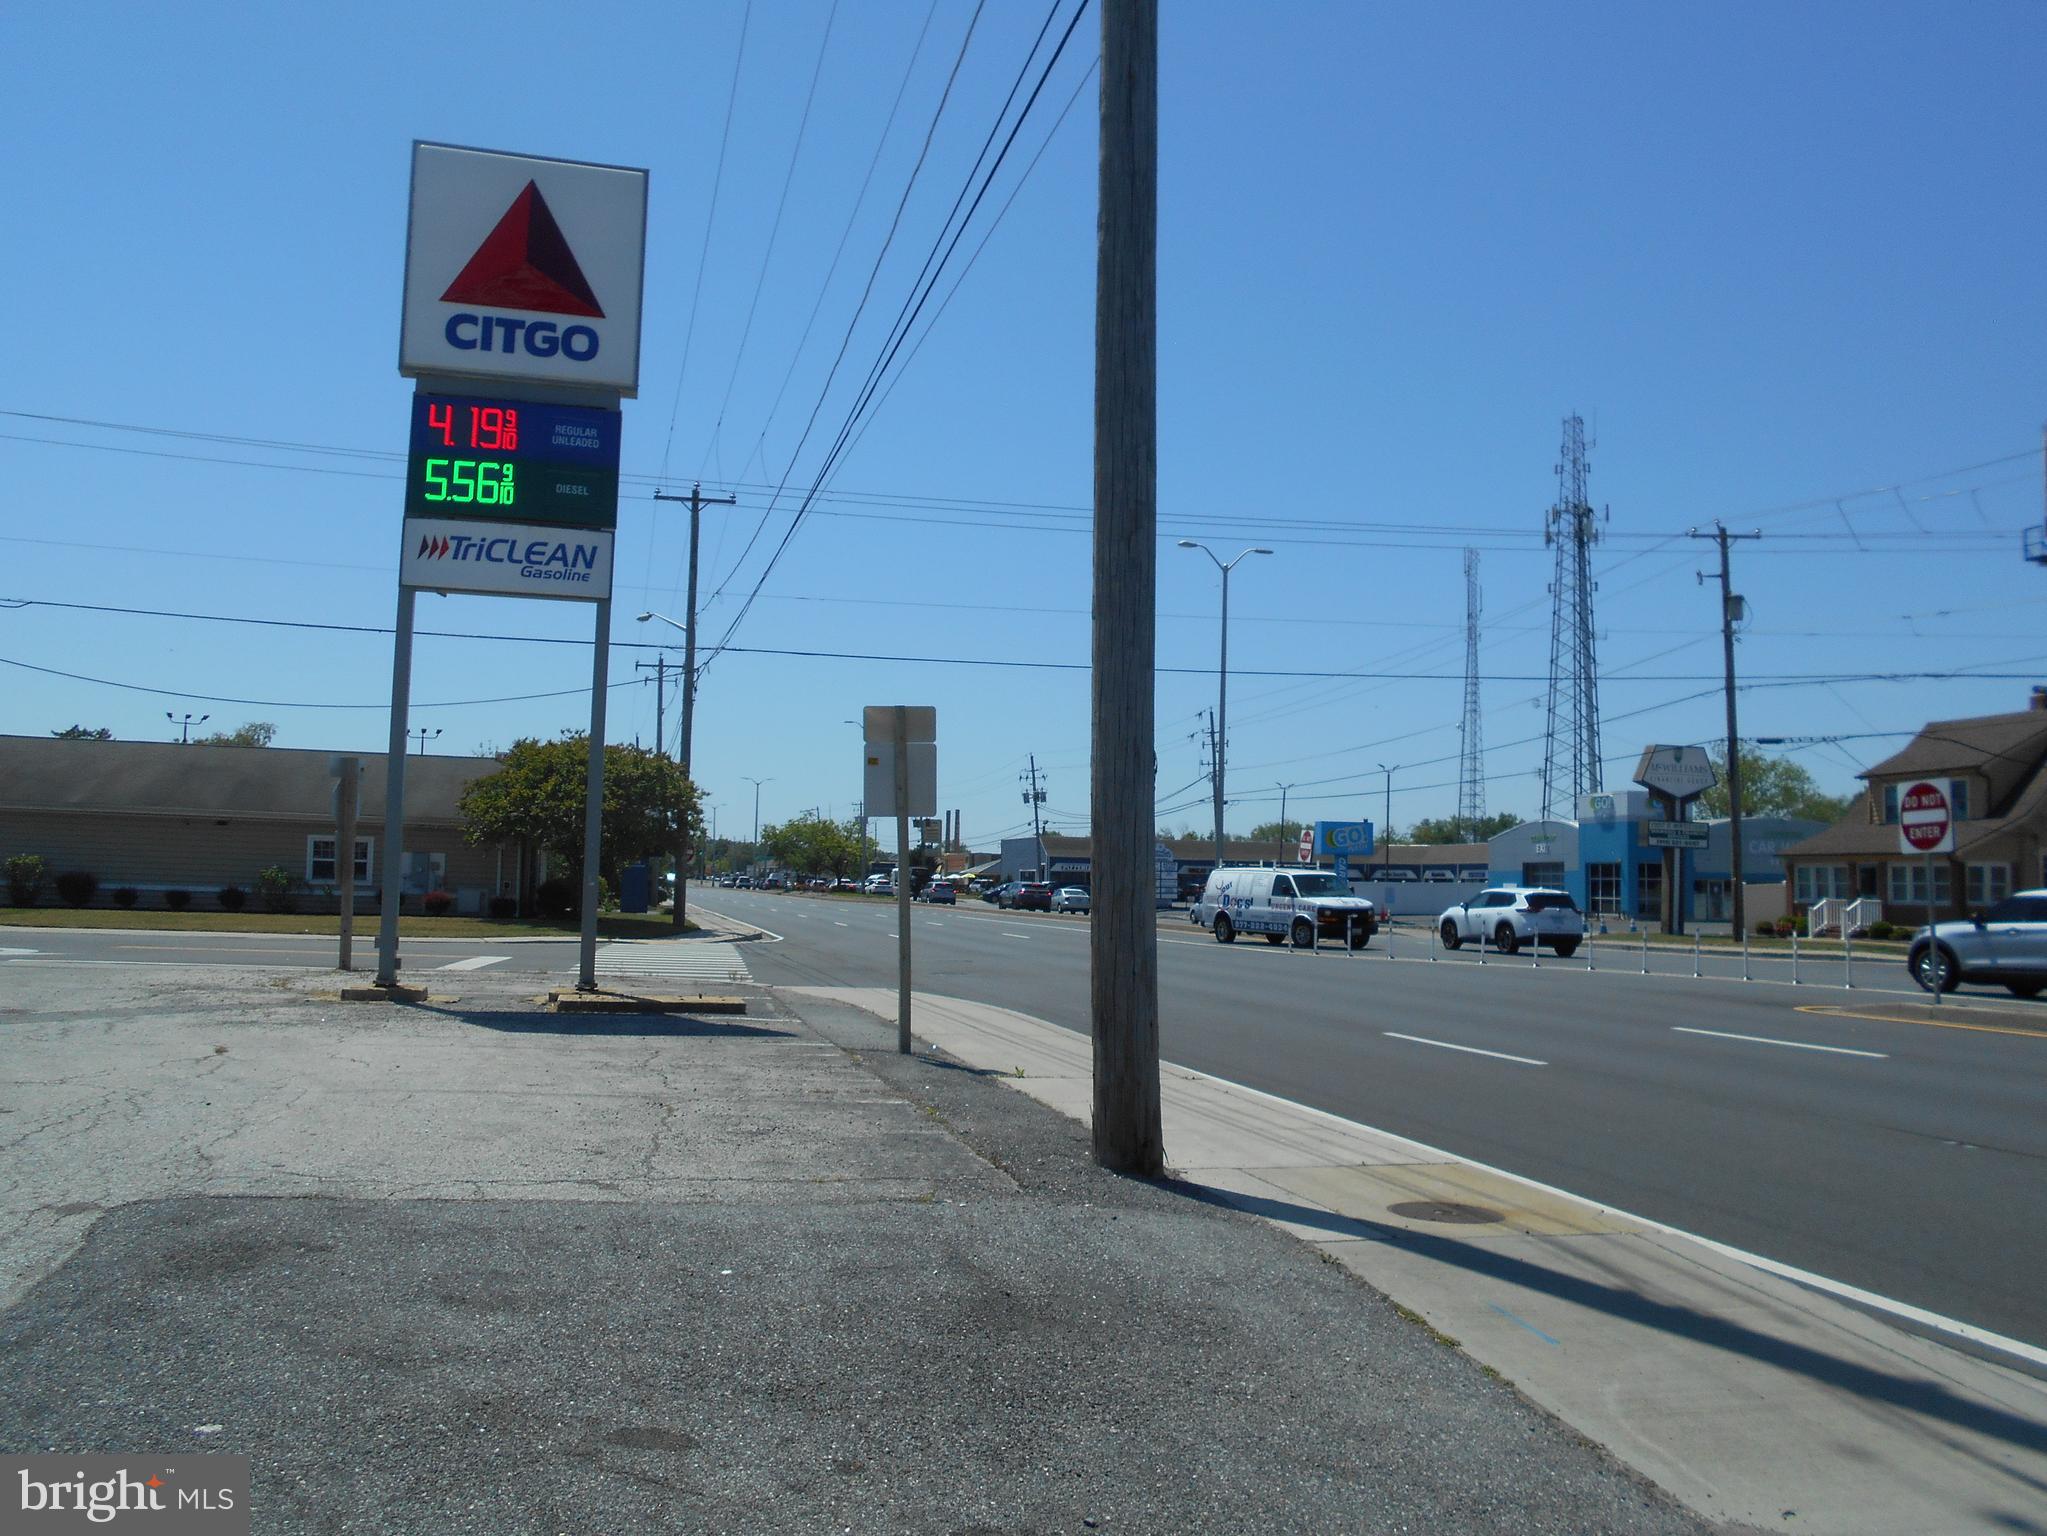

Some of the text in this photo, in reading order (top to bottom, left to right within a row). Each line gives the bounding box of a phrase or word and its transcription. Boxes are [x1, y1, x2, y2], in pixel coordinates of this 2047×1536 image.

[445, 313, 599, 362] CITGO
[555, 425, 597, 438] REGULAR
[552, 435, 599, 449] UNLEADED
[556, 484, 589, 496] DIESEL
[450, 535, 598, 569] TriCLEAN
[520, 565, 590, 582] Gasoline
[1904, 793, 1941, 808] DO NOT
[1910, 826, 1941, 839] ENTER
